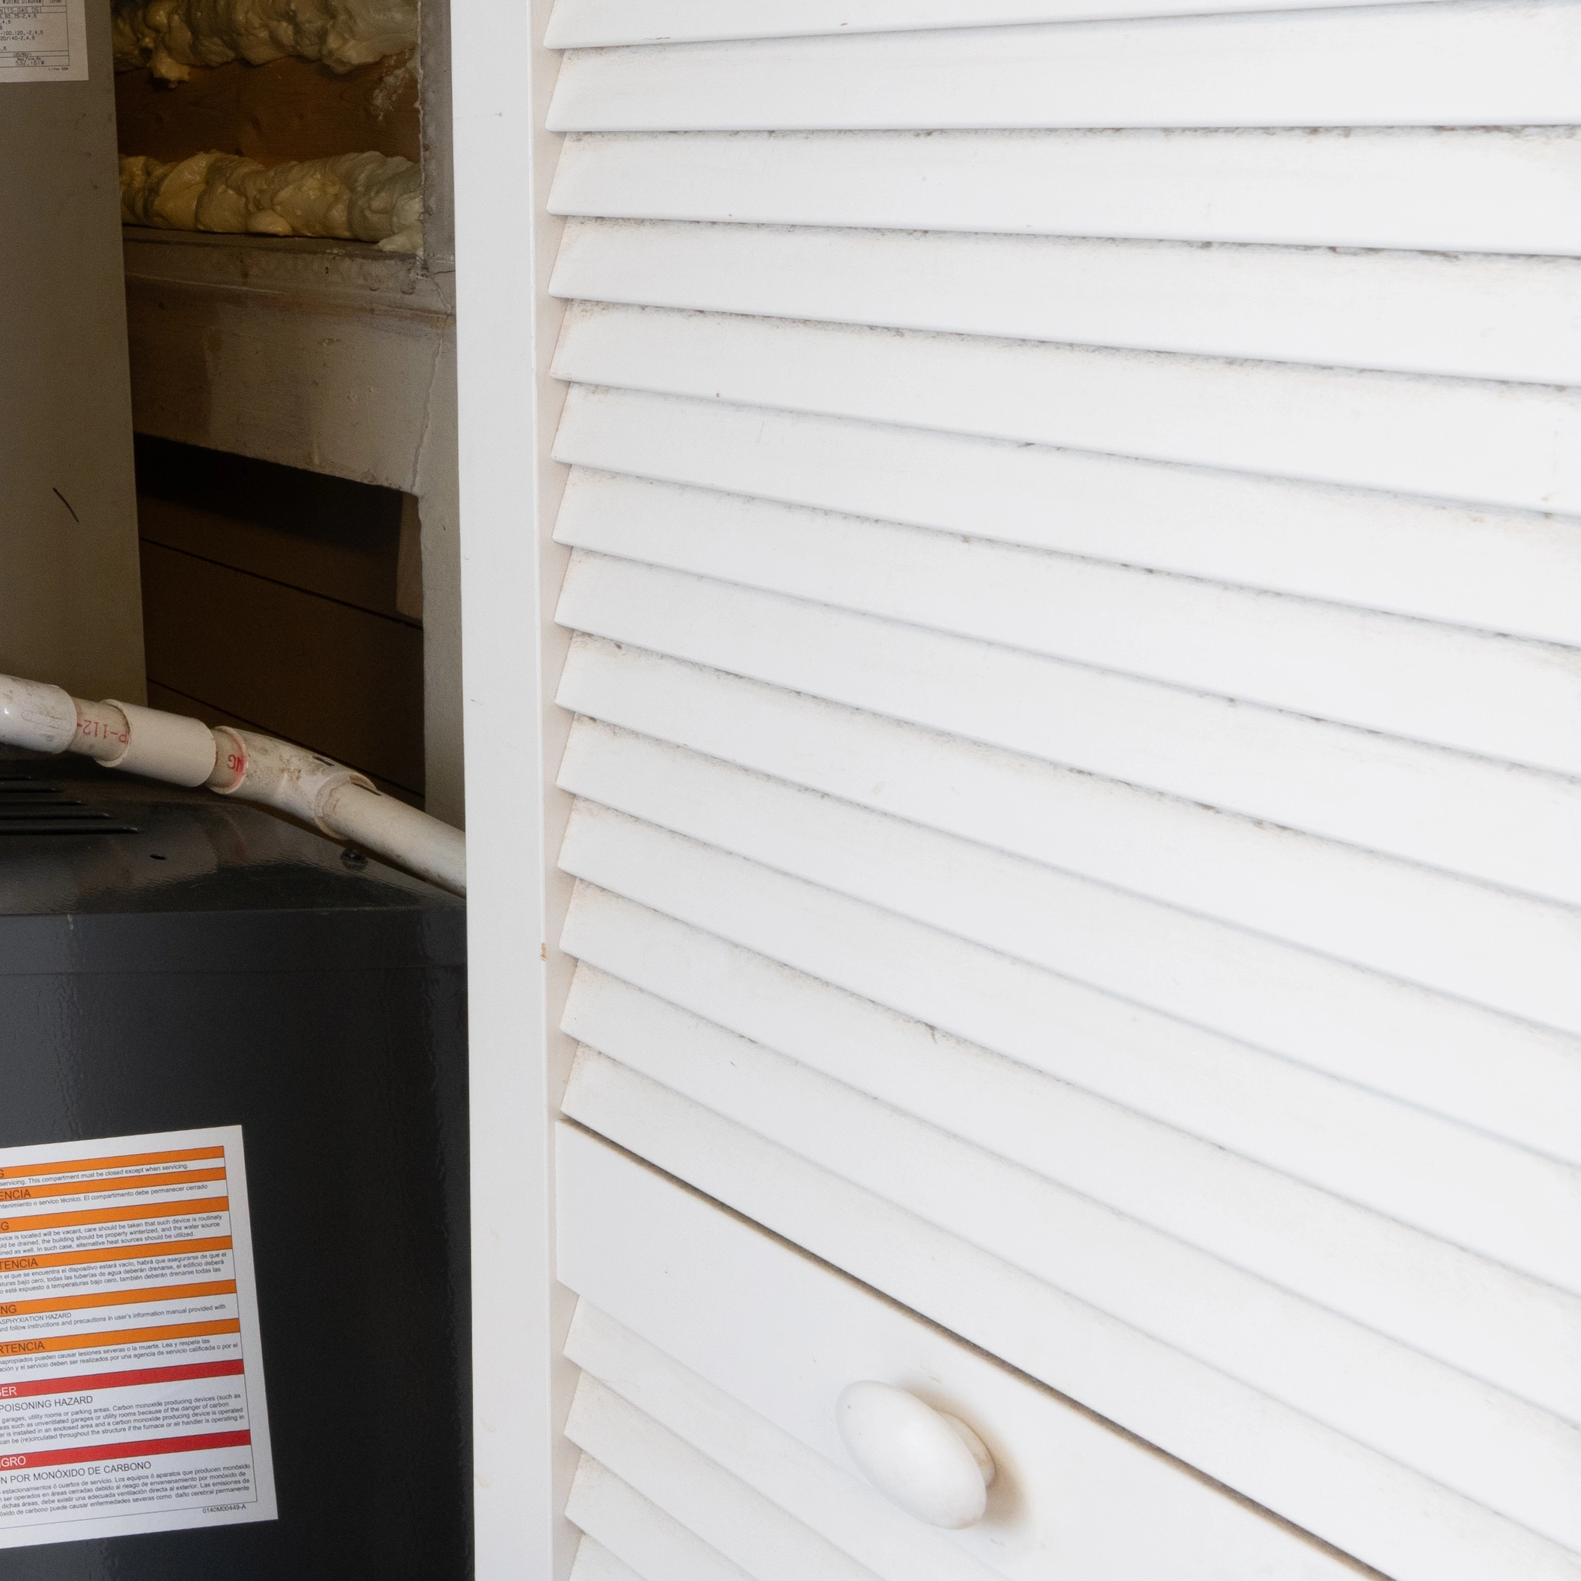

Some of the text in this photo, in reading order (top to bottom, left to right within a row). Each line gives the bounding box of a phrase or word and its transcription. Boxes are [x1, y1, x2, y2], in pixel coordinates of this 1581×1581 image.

[44, 1311, 71, 1319] HAZARD
[53, 1395, 93, 1406] HAZARD
[9, 1473, 30, 1483] POR
[32, 1467, 85, 1480] MONÓXIDO
[87, 1466, 101, 1475] DE
[103, 1460, 151, 1473] CARBONO
